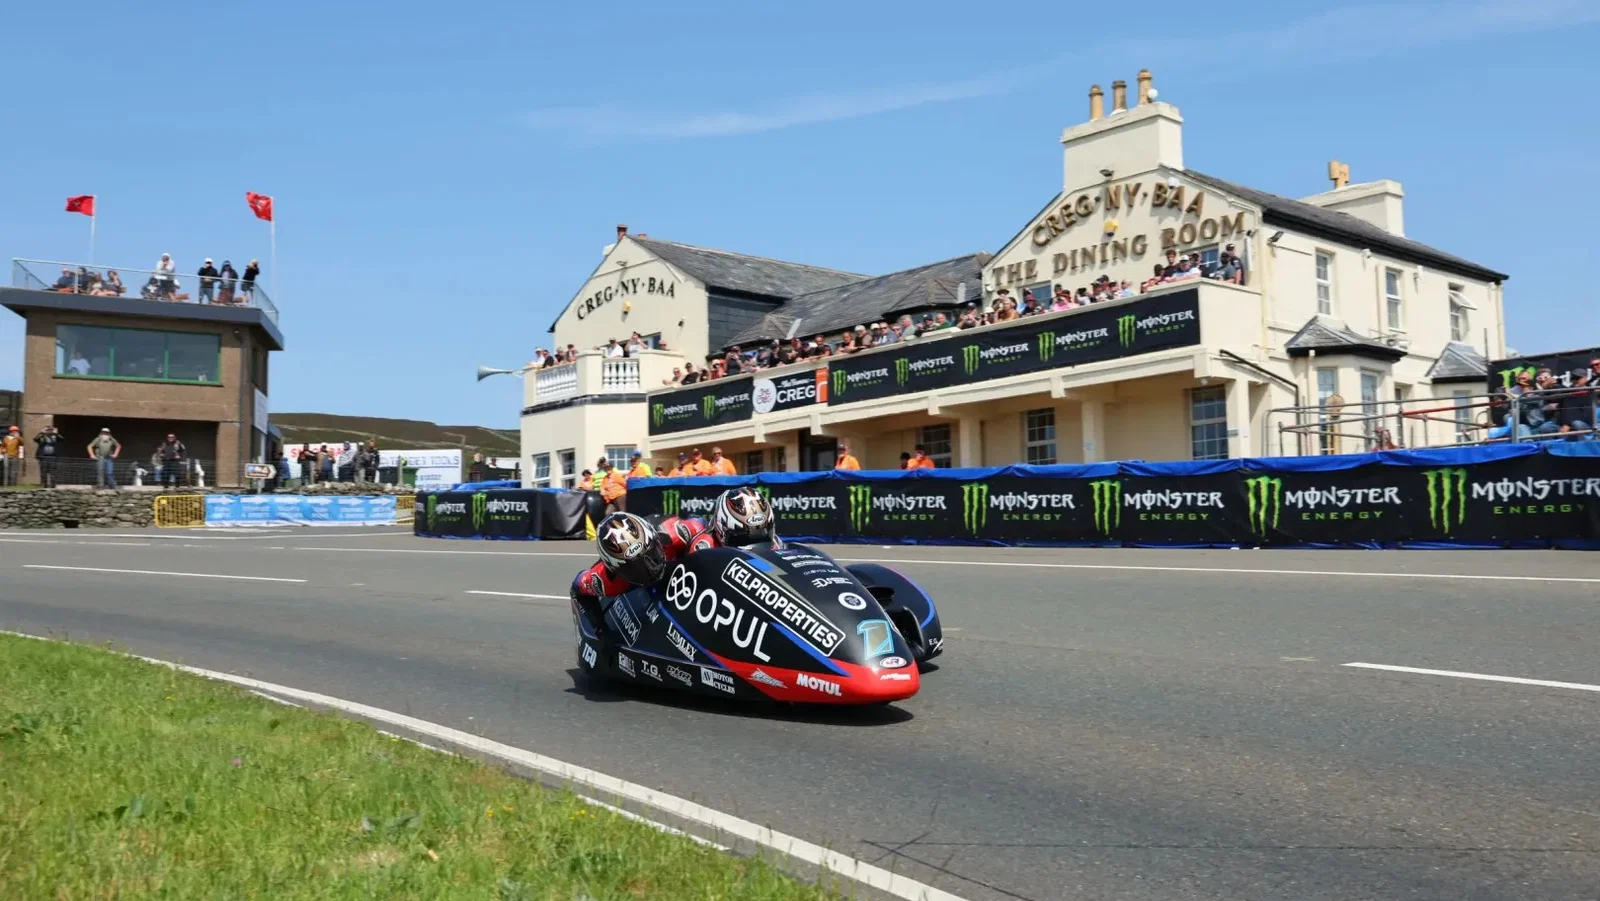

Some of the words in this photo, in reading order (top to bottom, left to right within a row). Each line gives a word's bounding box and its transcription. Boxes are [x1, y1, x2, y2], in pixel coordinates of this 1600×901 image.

[992, 259, 1038, 287] THE
[1053, 234, 1149, 274] DINING
[1162, 211, 1246, 249] ROOM
[777, 384, 816, 403] CREG
[873, 494, 947, 511] MONSTER
[990, 491, 1076, 511] MONSTER
[1124, 489, 1225, 511] MONSTER
[1284, 486, 1403, 509] MONSTER
[1003, 513, 1062, 521] ENERGY
[1140, 513, 1209, 521] ENERGY
[1302, 511, 1383, 521] ENERGY
[1493, 503, 1585, 515] ENERGY
[727, 563, 838, 648] KELPROPERTIES
[613, 597, 639, 641] KELTRUCK
[695, 588, 771, 663] OPUL
[667, 621, 698, 662] LUMLEY
[713, 671, 733, 685] MOTOR
[713, 682, 736, 694] CYCLES
[796, 673, 842, 697] MOTUL
